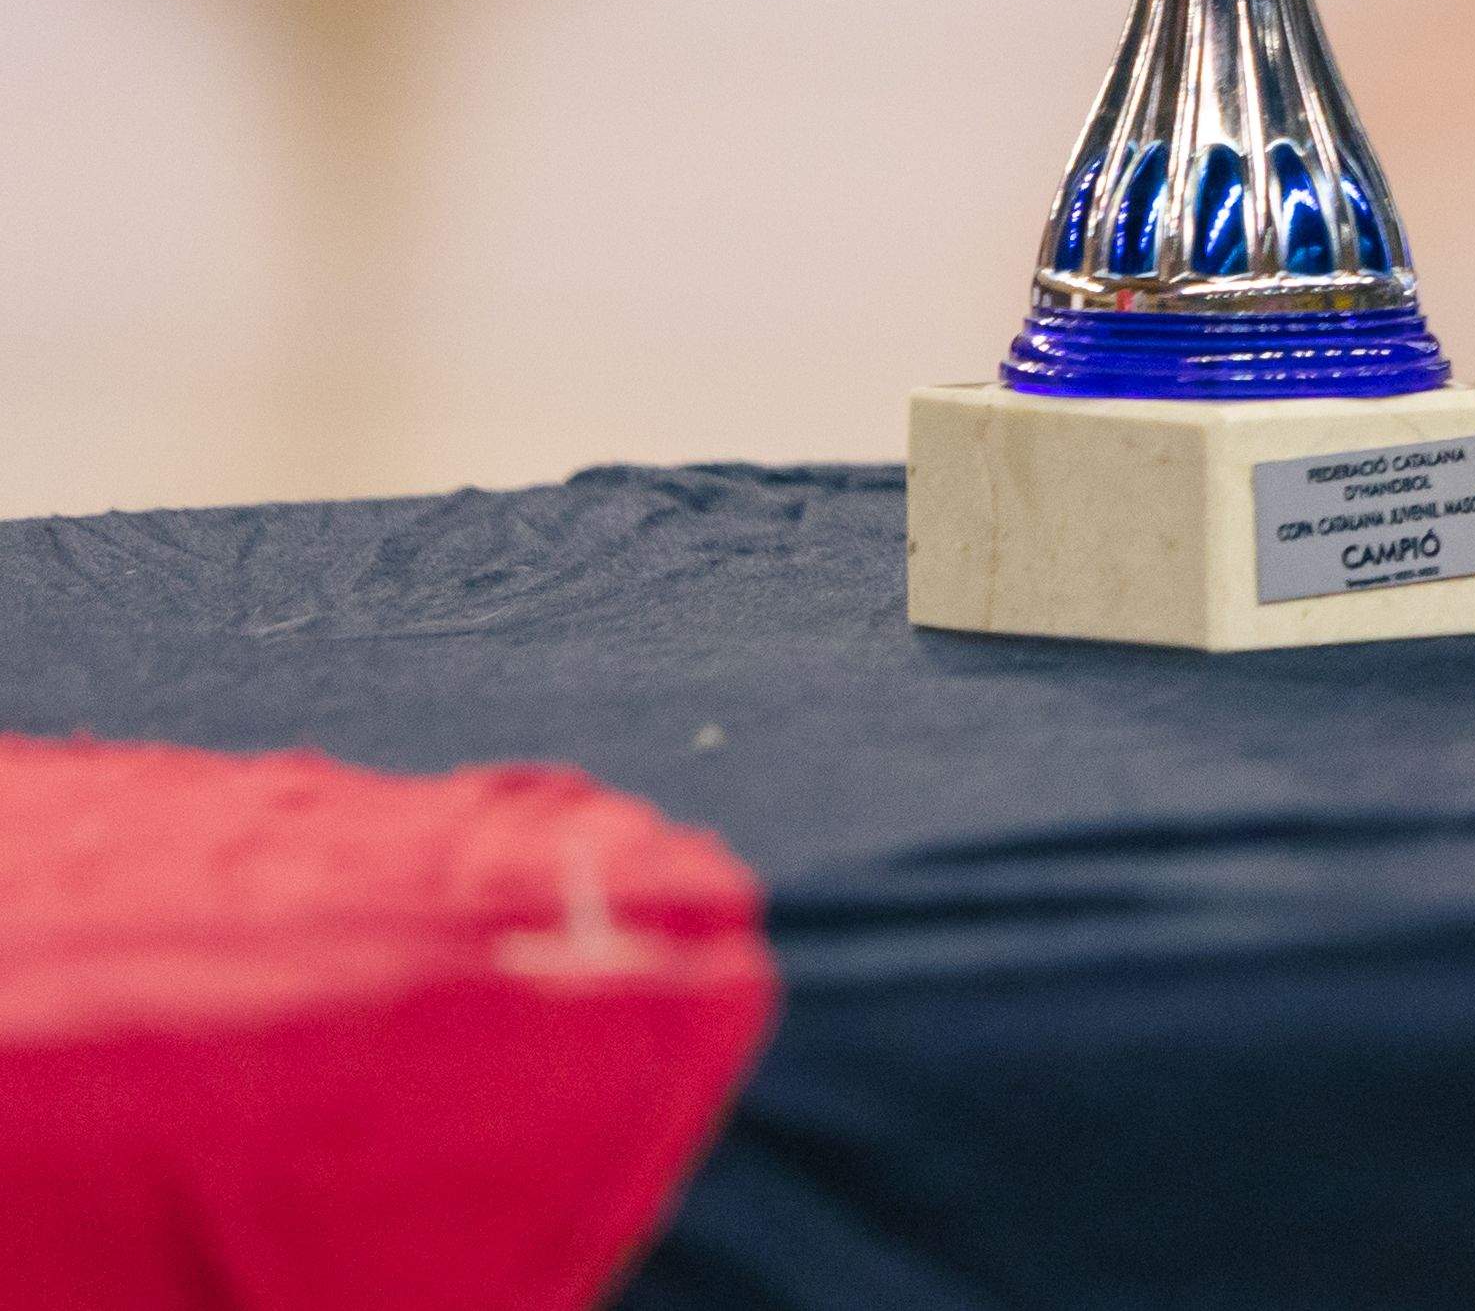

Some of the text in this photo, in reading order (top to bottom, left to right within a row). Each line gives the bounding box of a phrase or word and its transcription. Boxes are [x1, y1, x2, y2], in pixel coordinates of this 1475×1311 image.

[1392, 445, 1466, 471] CATALANA
[1318, 510, 1384, 536] CATALANA
[1341, 528, 1440, 569] CAMPIÓ
